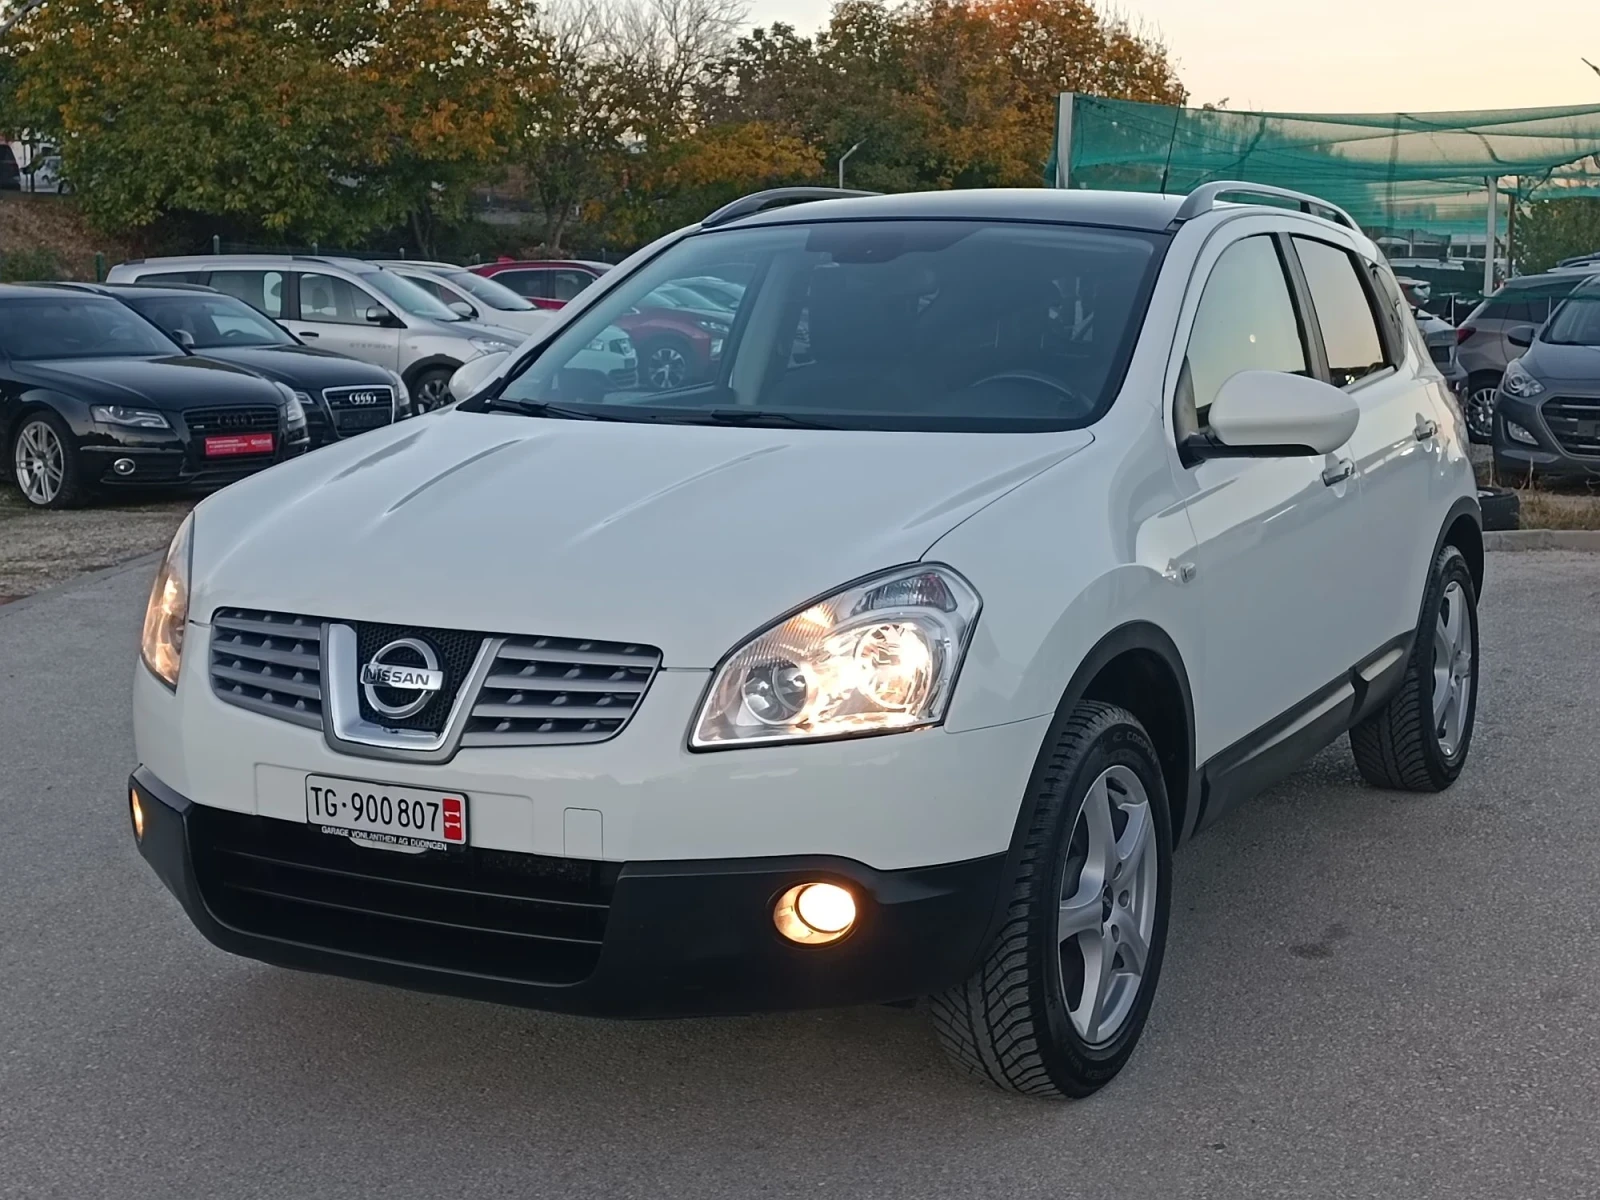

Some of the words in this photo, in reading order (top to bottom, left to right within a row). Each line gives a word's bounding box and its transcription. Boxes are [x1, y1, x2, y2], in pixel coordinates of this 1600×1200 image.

[363, 668, 429, 685] NISSAN
[321, 826, 349, 836] GARAGE
[351, 830, 396, 844] VONLANTHEN
[398, 837, 408, 845] AG
